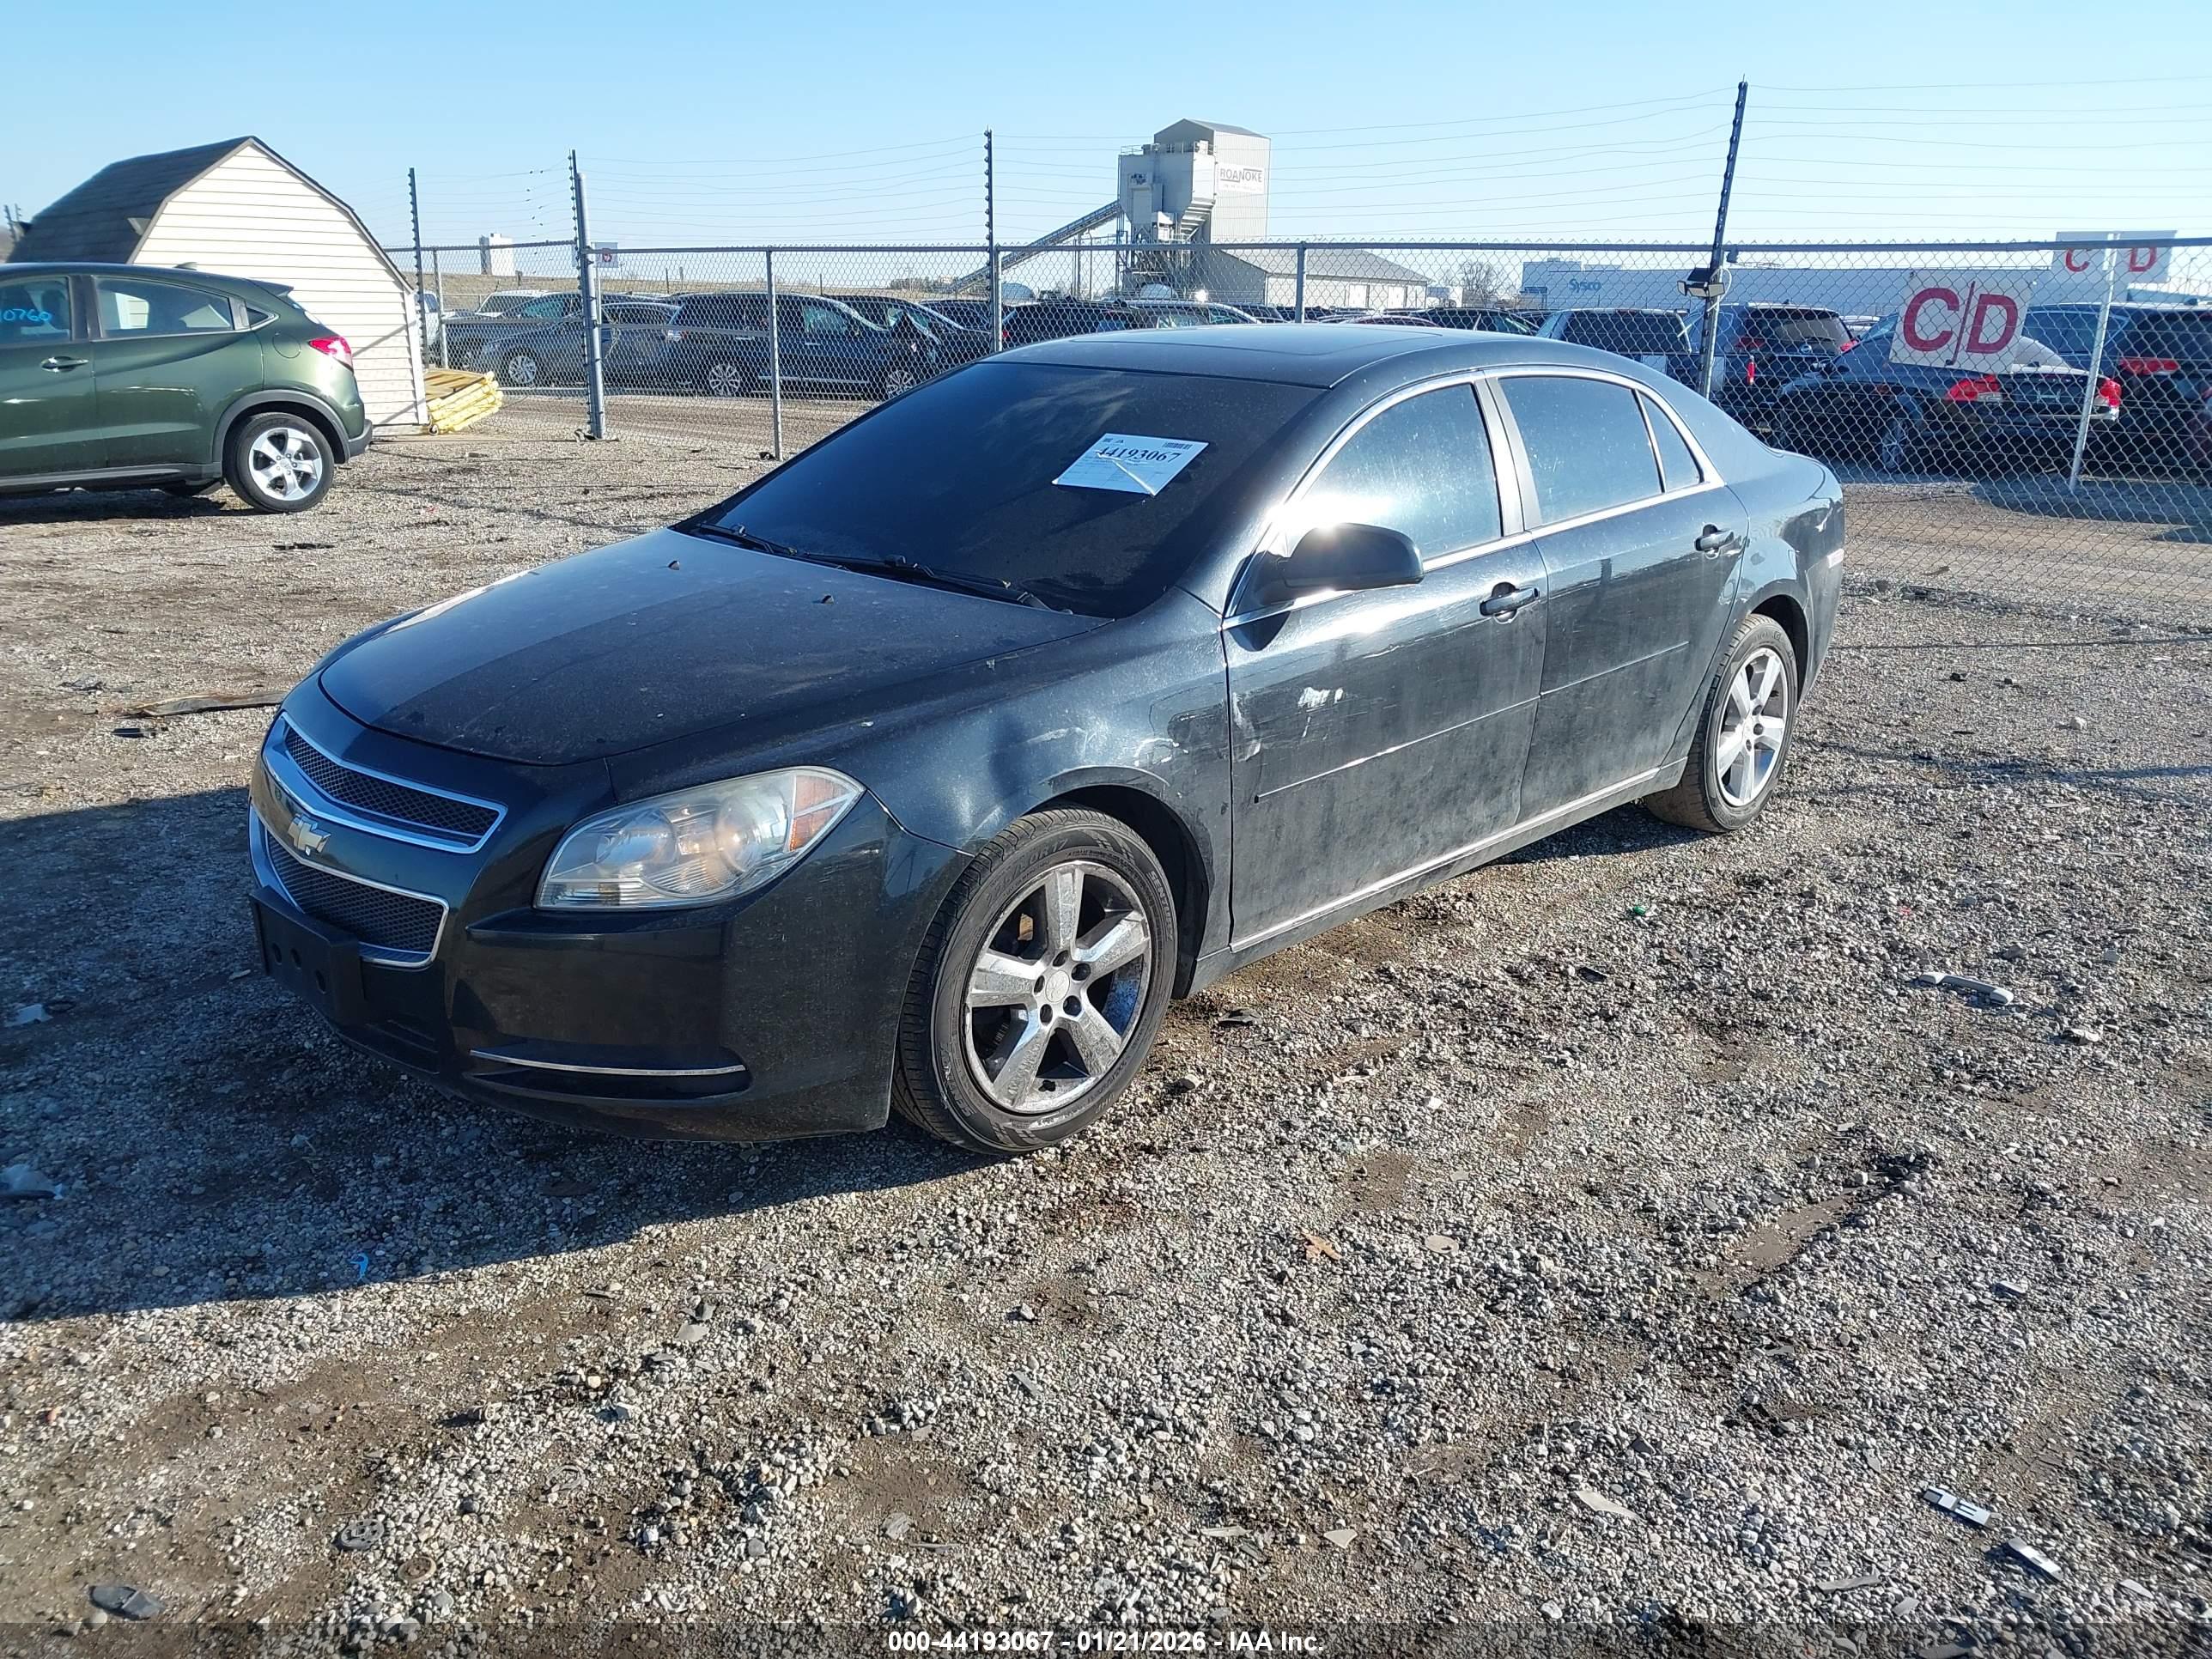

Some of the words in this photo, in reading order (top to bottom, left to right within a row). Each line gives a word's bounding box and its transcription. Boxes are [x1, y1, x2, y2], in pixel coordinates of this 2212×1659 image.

[1219, 168, 1262, 182] ROANOKE
[1568, 278, 1601, 293] Sysco
[0, 308, 52, 322] 0760
[1097, 447, 1182, 463] 44193067
